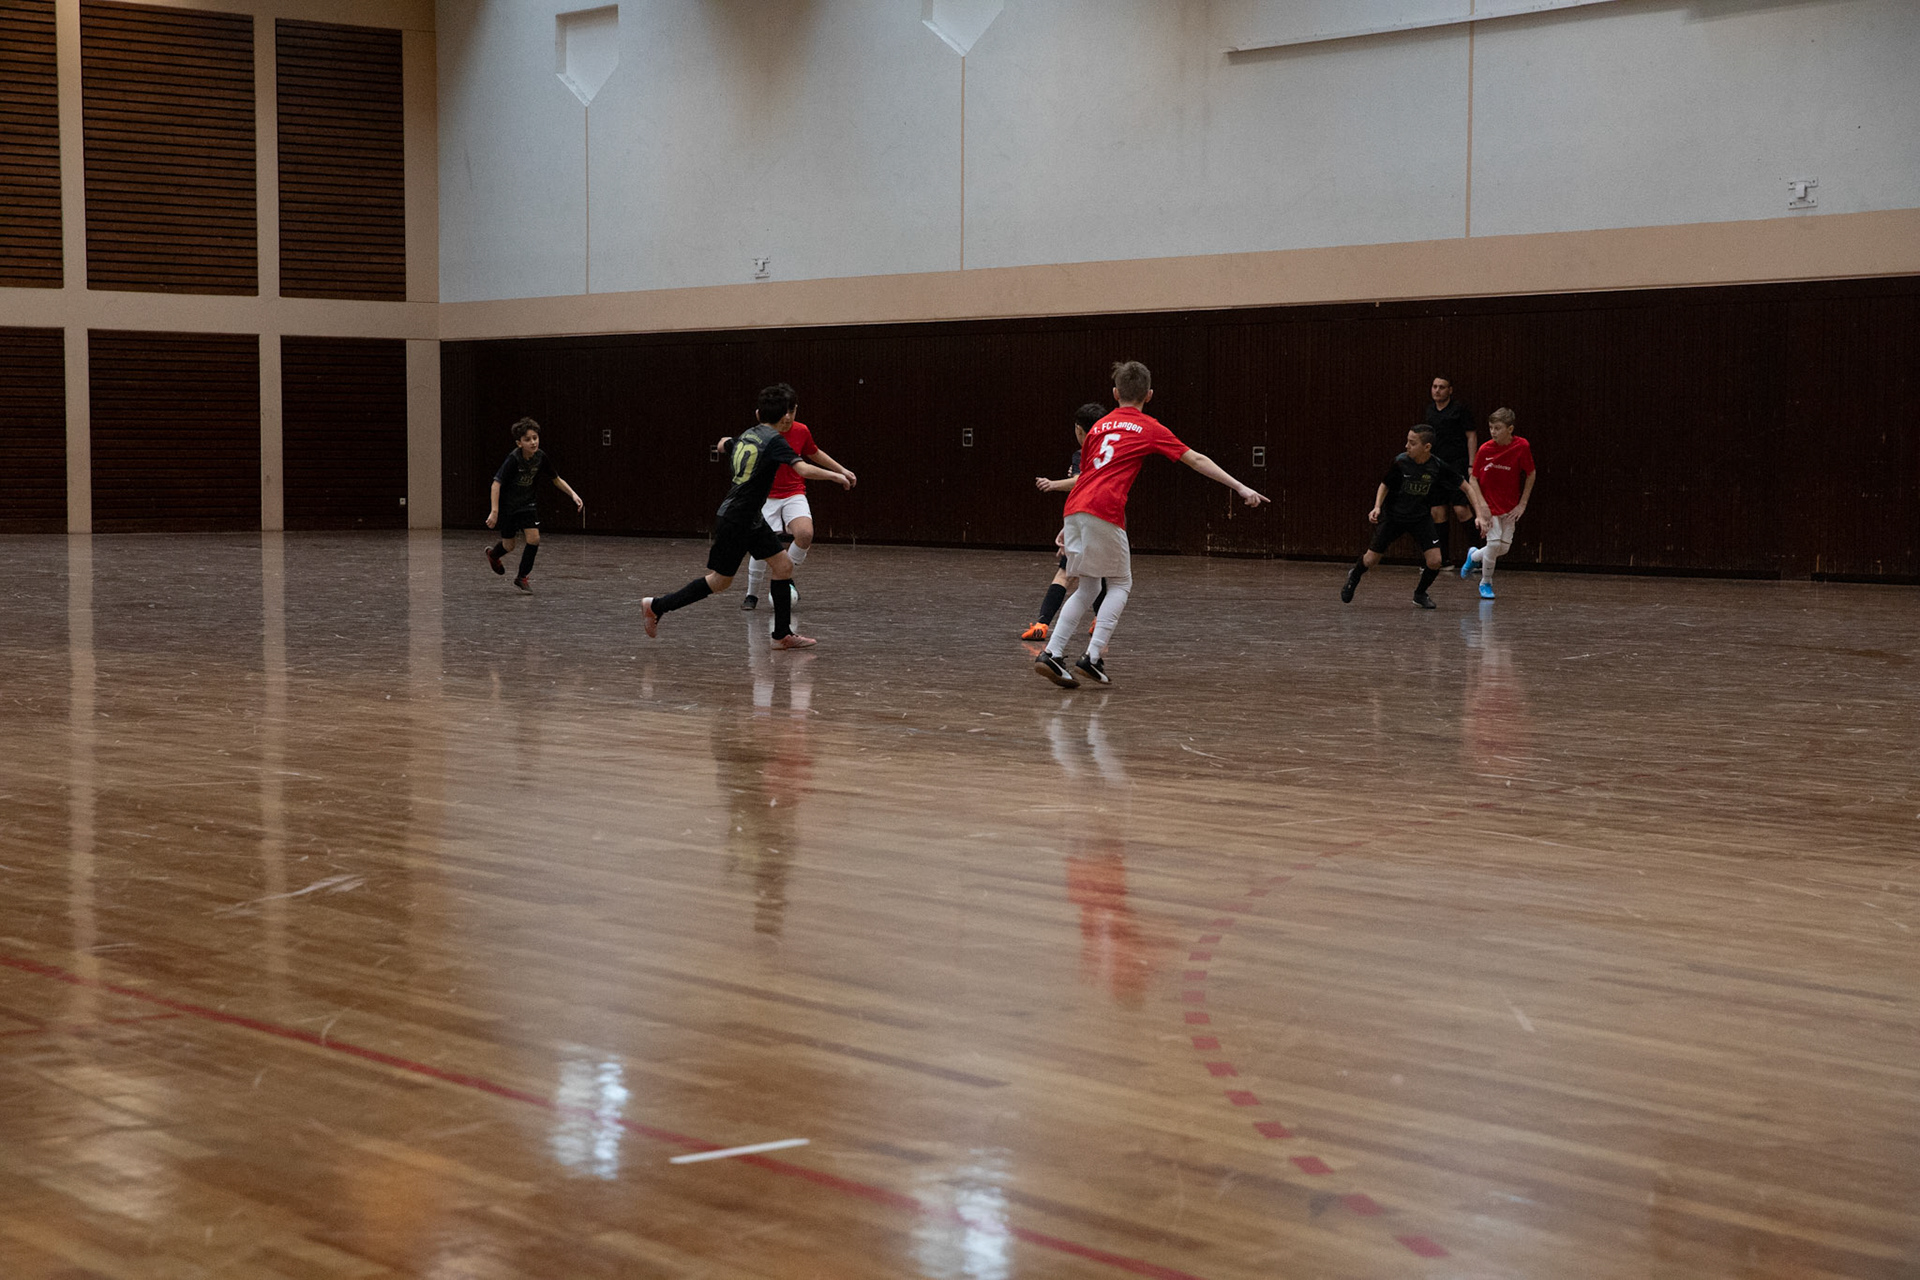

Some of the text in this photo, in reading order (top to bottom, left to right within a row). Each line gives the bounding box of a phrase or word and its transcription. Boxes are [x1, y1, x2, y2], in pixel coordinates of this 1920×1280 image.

[1101, 421, 1113, 431] FC
[1113, 420, 1143, 434] Langen
[732, 441, 759, 485] 10
[1092, 433, 1122, 470] 5
